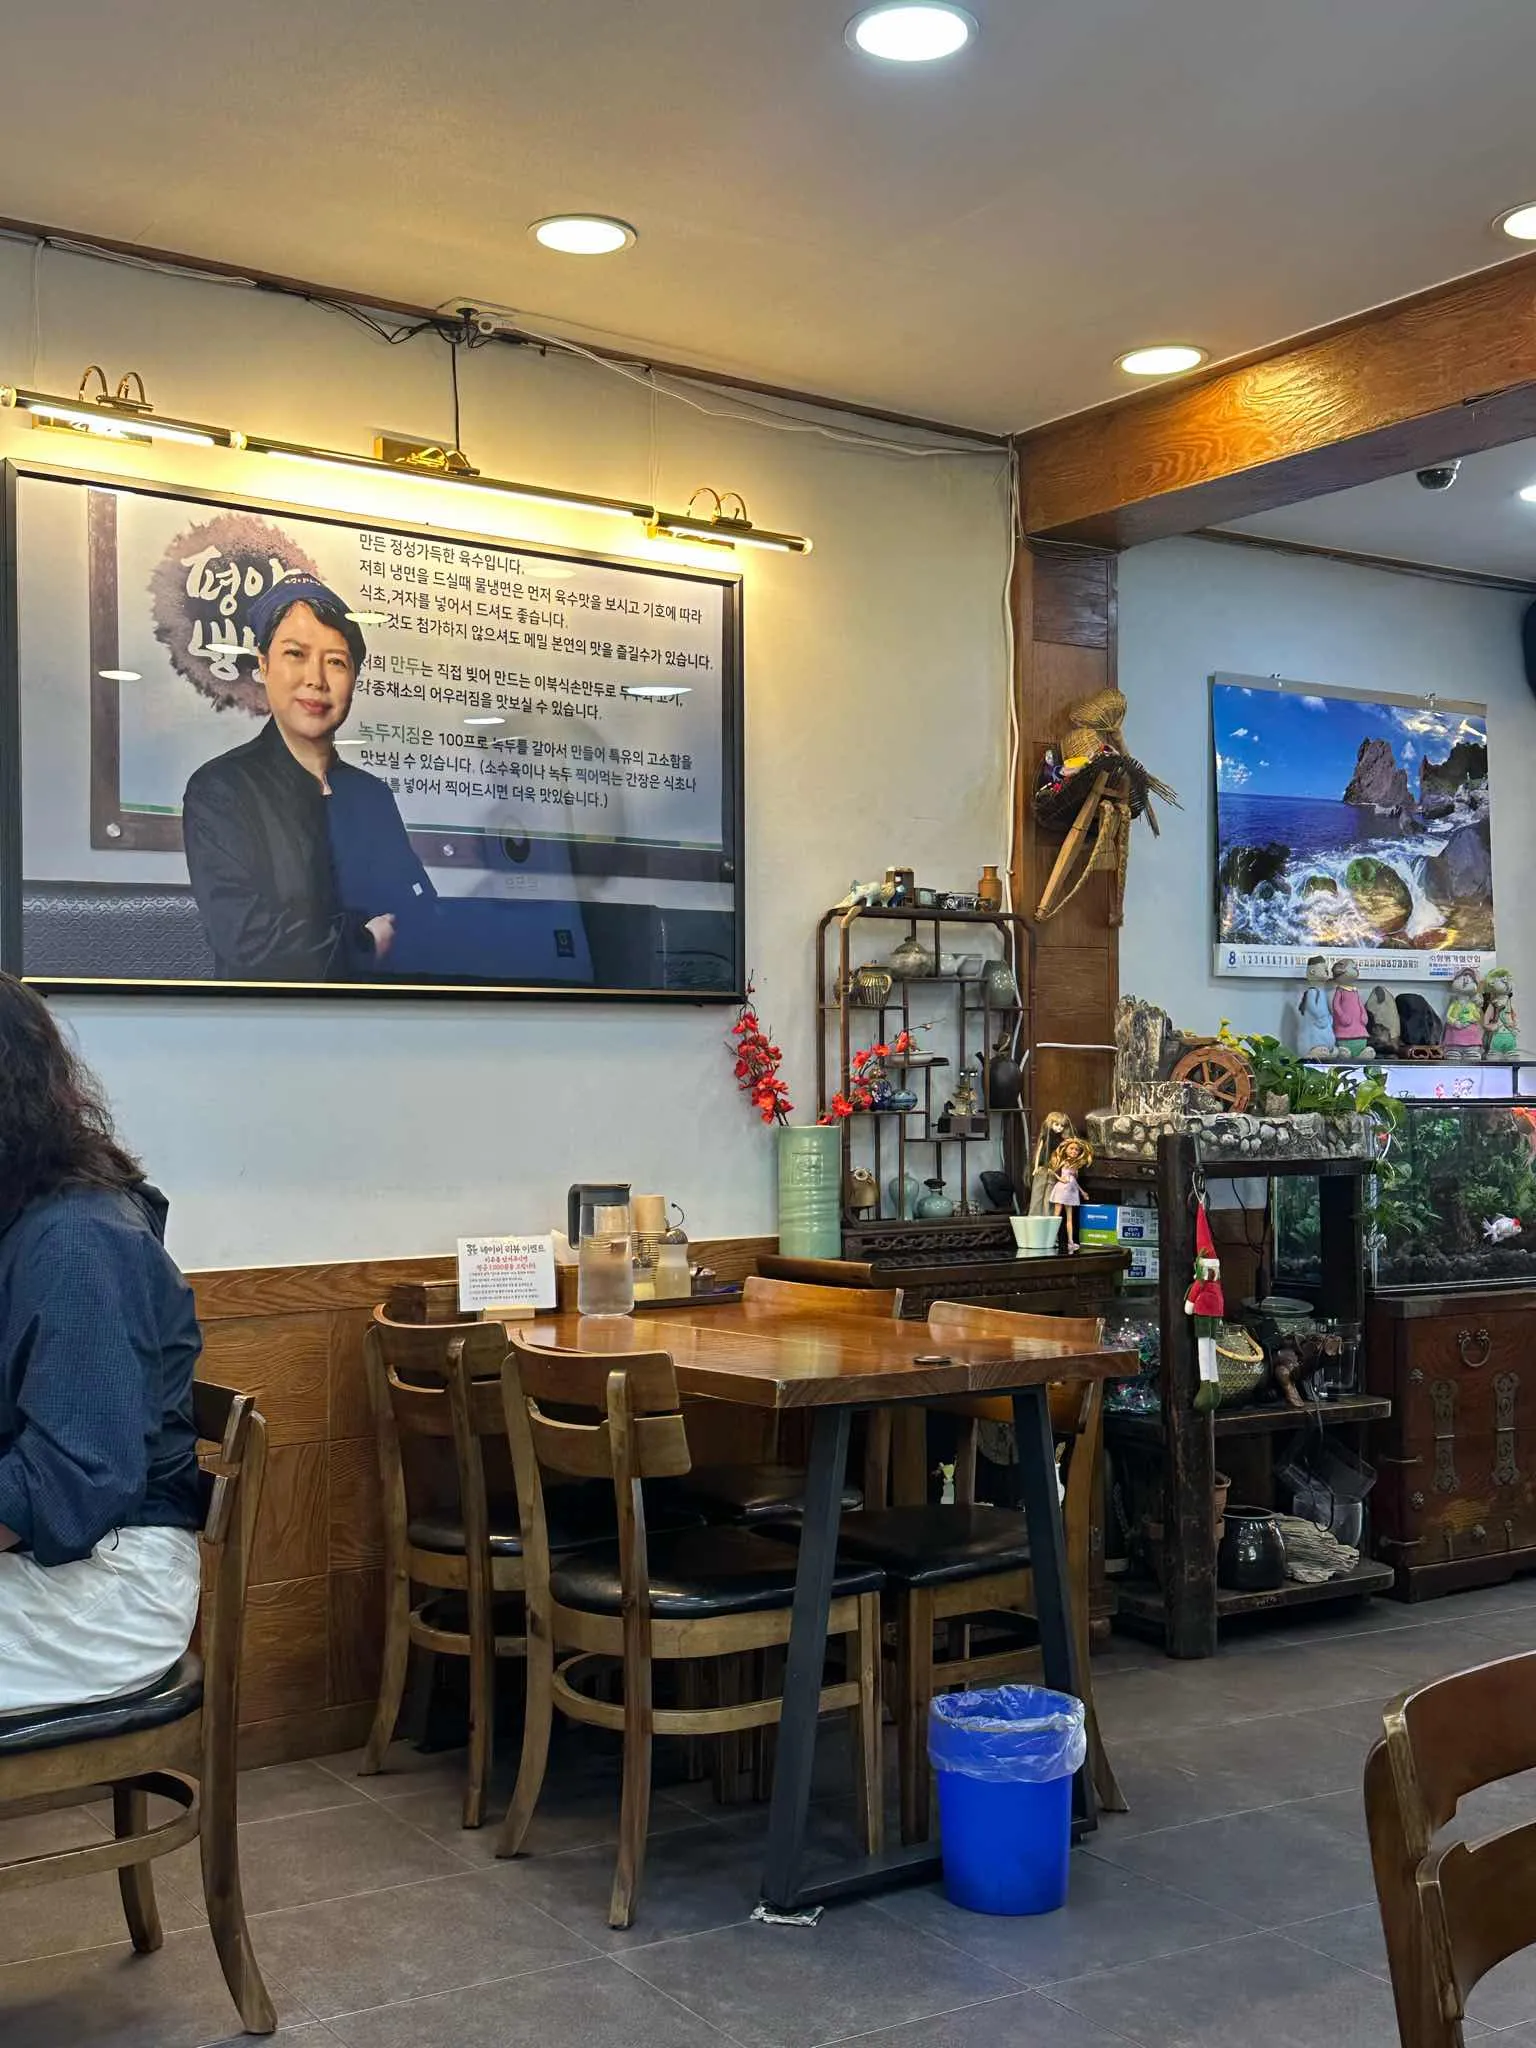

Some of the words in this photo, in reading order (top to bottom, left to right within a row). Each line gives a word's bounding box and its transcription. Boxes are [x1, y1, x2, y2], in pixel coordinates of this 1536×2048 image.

[359, 533, 387, 553] 만든
[390, 538, 455, 564] 정성가득한
[458, 550, 525, 575] 육수입니다.
[359, 559, 386, 579] 저희
[390, 564, 429, 585] 냉면을
[433, 571, 471, 592] 드실때
[474, 577, 524, 599] 물냉면은
[528, 585, 551, 604] 먼저
[555, 589, 602, 610] 육수맛을
[605, 597, 640, 614] 보시고
[643, 603, 676, 621] 기호에
[679, 607, 702, 624] 따라
[435, 595, 472, 616] 넣어서
[476, 602, 513, 621] 드셔도
[516, 607, 568, 629] 좋습니다.
[360, 609, 413, 630] 것도
[416, 616, 467, 640] 첨가하지
[471, 625, 521, 645] 않으셔도
[524, 632, 547, 650] 메밀
[551, 635, 586, 655] 본연의
[590, 641, 613, 658] 맛을
[616, 644, 661, 665] 즐길수가
[665, 650, 713, 670] 있습니다.
[390, 655, 433, 678] 만두는
[437, 663, 462, 681] 직접
[466, 667, 490, 684] 빚어
[494, 670, 530, 689] 만드는
[356, 679, 425, 700] 각종채소의
[430, 687, 492, 709] 어우러짐을
[497, 694, 532, 714] 맛보실
[536, 700, 548, 714] 수
[551, 700, 602, 720] 있습니다.
[358, 721, 434, 746] 녹두지짐은
[438, 732, 489, 750] 100프로
[532, 741, 567, 759] 갈아서
[571, 745, 606, 763] 만들어
[609, 748, 643, 766] 특유의
[647, 751, 693, 770] 고소함을
[361, 750, 400, 770] 맛보실
[403, 752, 417, 769] 수
[420, 753, 475, 773] 있습니다.
[549, 766, 573, 783] 녹두
[576, 768, 623, 786] 찍어먹는
[626, 772, 660, 790] 간장은
[664, 776, 697, 793] 식초나
[404, 778, 441, 795] 넣어서
[445, 779, 508, 800] 찍어드시면
[512, 785, 536, 802] 더욱
[540, 787, 608, 808] 맛있습니다.)
[1228, 950, 1237, 965] 8
